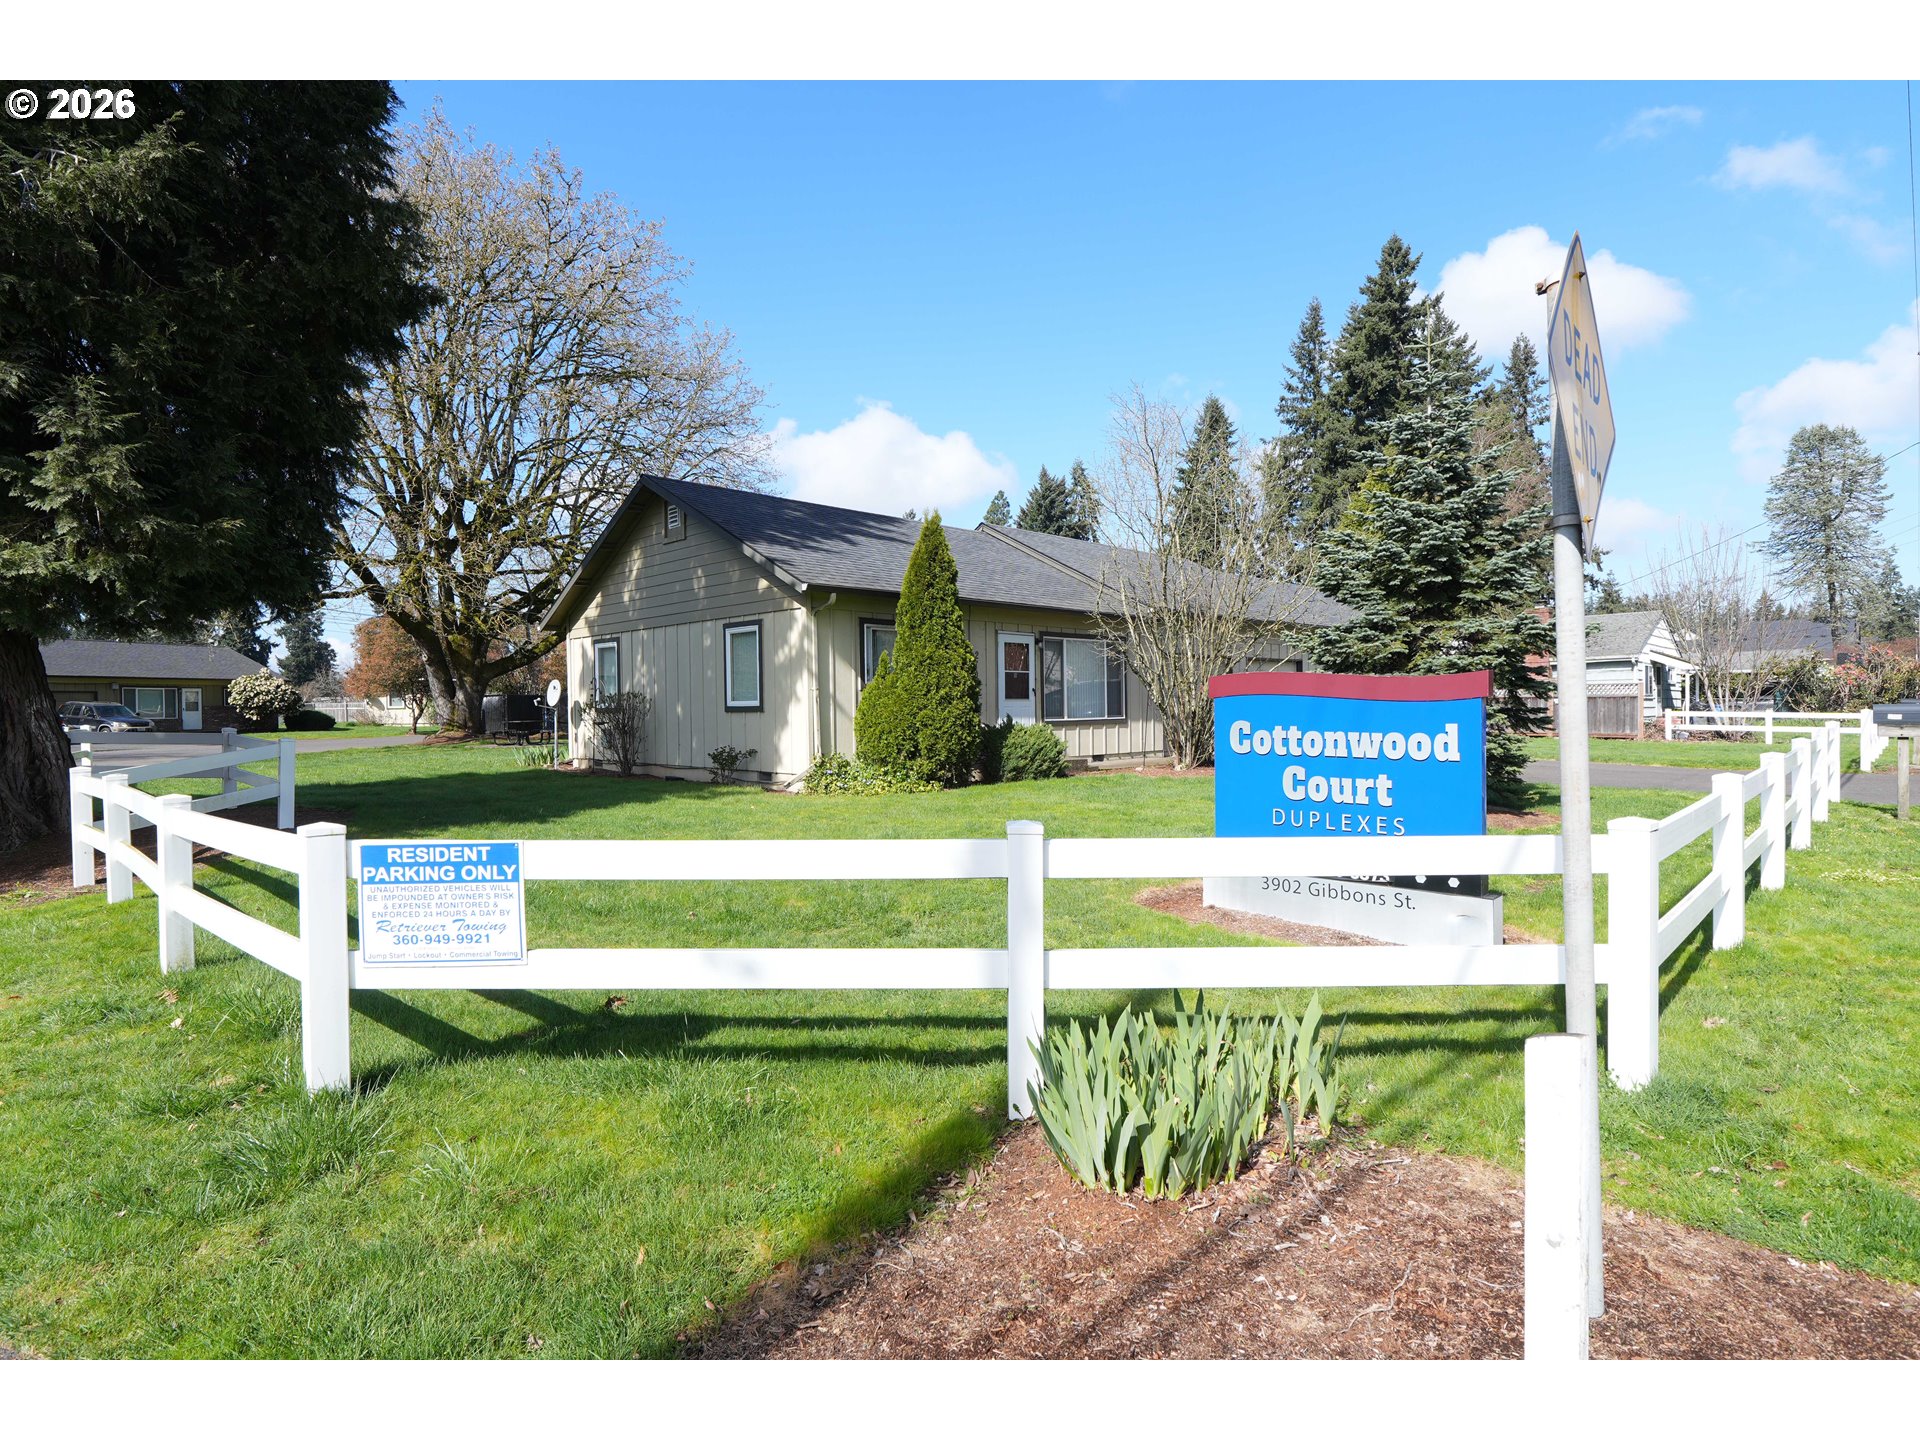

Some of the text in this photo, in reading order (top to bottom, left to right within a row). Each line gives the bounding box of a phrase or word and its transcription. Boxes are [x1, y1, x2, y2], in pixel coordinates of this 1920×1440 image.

[1563, 309, 1601, 406] DEAD
[1572, 402, 1597, 477] END
[1229, 720, 1461, 762] Cottonwood
[1282, 765, 1393, 807] Court
[1272, 808, 1405, 836] DUPLEXES
[387, 846, 491, 863] RESIDENT
[362, 864, 517, 882] PARKING ONLY
[369, 885, 440, 893] UNAUTHORIZED
[443, 884, 487, 892] VEHICLES
[1261, 876, 1416, 910] 3902 Gibbons St.
[367, 894, 378, 902] BE
[381, 893, 435, 901] IMPOUNDED
[383, 902, 389, 910] &
[391, 902, 432, 910] EXPENSE
[435, 901, 490, 909] MONITORED
[479, 909, 496, 917] DAY
[376, 918, 507, 935] Retriever Towing
[393, 933, 490, 945] 360-949-9921
[368, 952, 387, 960] Jump
[493, 950, 518, 958] Towing
